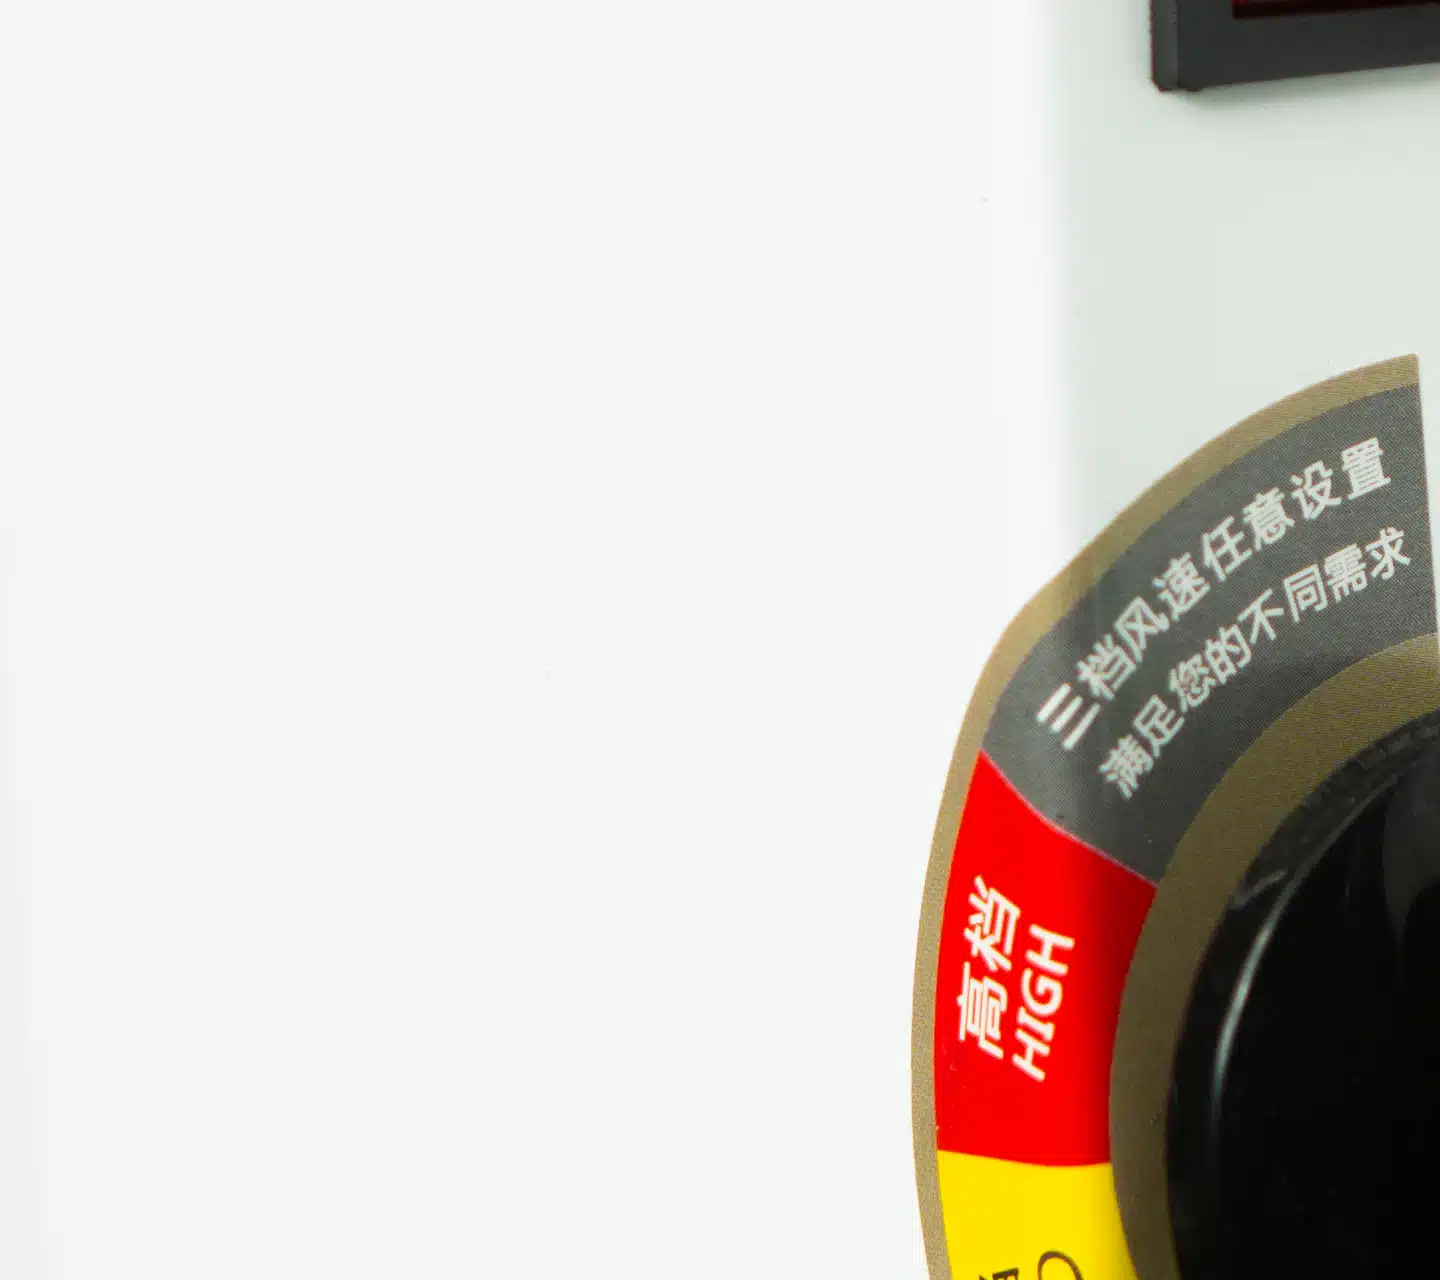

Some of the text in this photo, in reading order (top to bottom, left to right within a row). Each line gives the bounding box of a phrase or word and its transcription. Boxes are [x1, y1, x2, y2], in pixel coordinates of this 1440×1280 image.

[1035, 436, 1393, 750] 三档风速任意设置
[1098, 525, 1412, 800] 满足您的不同需求
[955, 874, 1023, 1060] 高档
[1010, 922, 1076, 1083] HIGH
